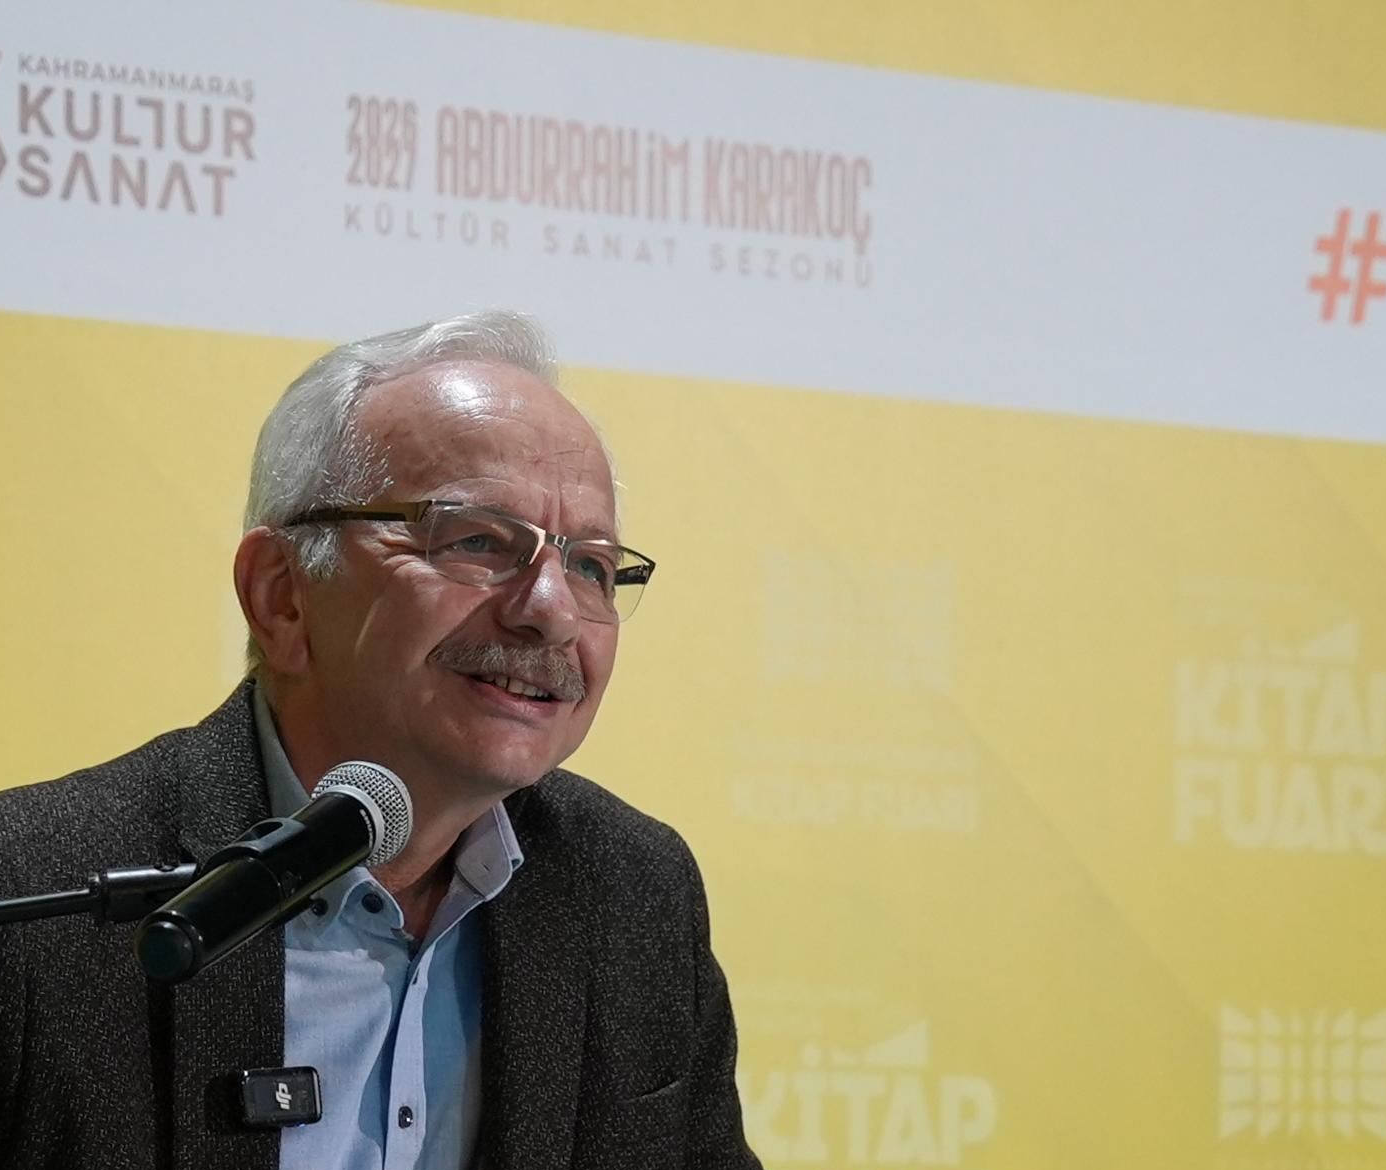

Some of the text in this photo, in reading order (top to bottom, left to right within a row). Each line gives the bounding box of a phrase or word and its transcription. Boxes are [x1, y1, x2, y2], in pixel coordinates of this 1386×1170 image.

[17, 51, 255, 104] KAHRAMANMARAŞ
[346, 92, 419, 144] 2026
[15, 142, 238, 218] SANAT
[346, 136, 418, 192] 2027
[702, 135, 873, 258] KARAKOÇ
[542, 223, 677, 266] SANAT
